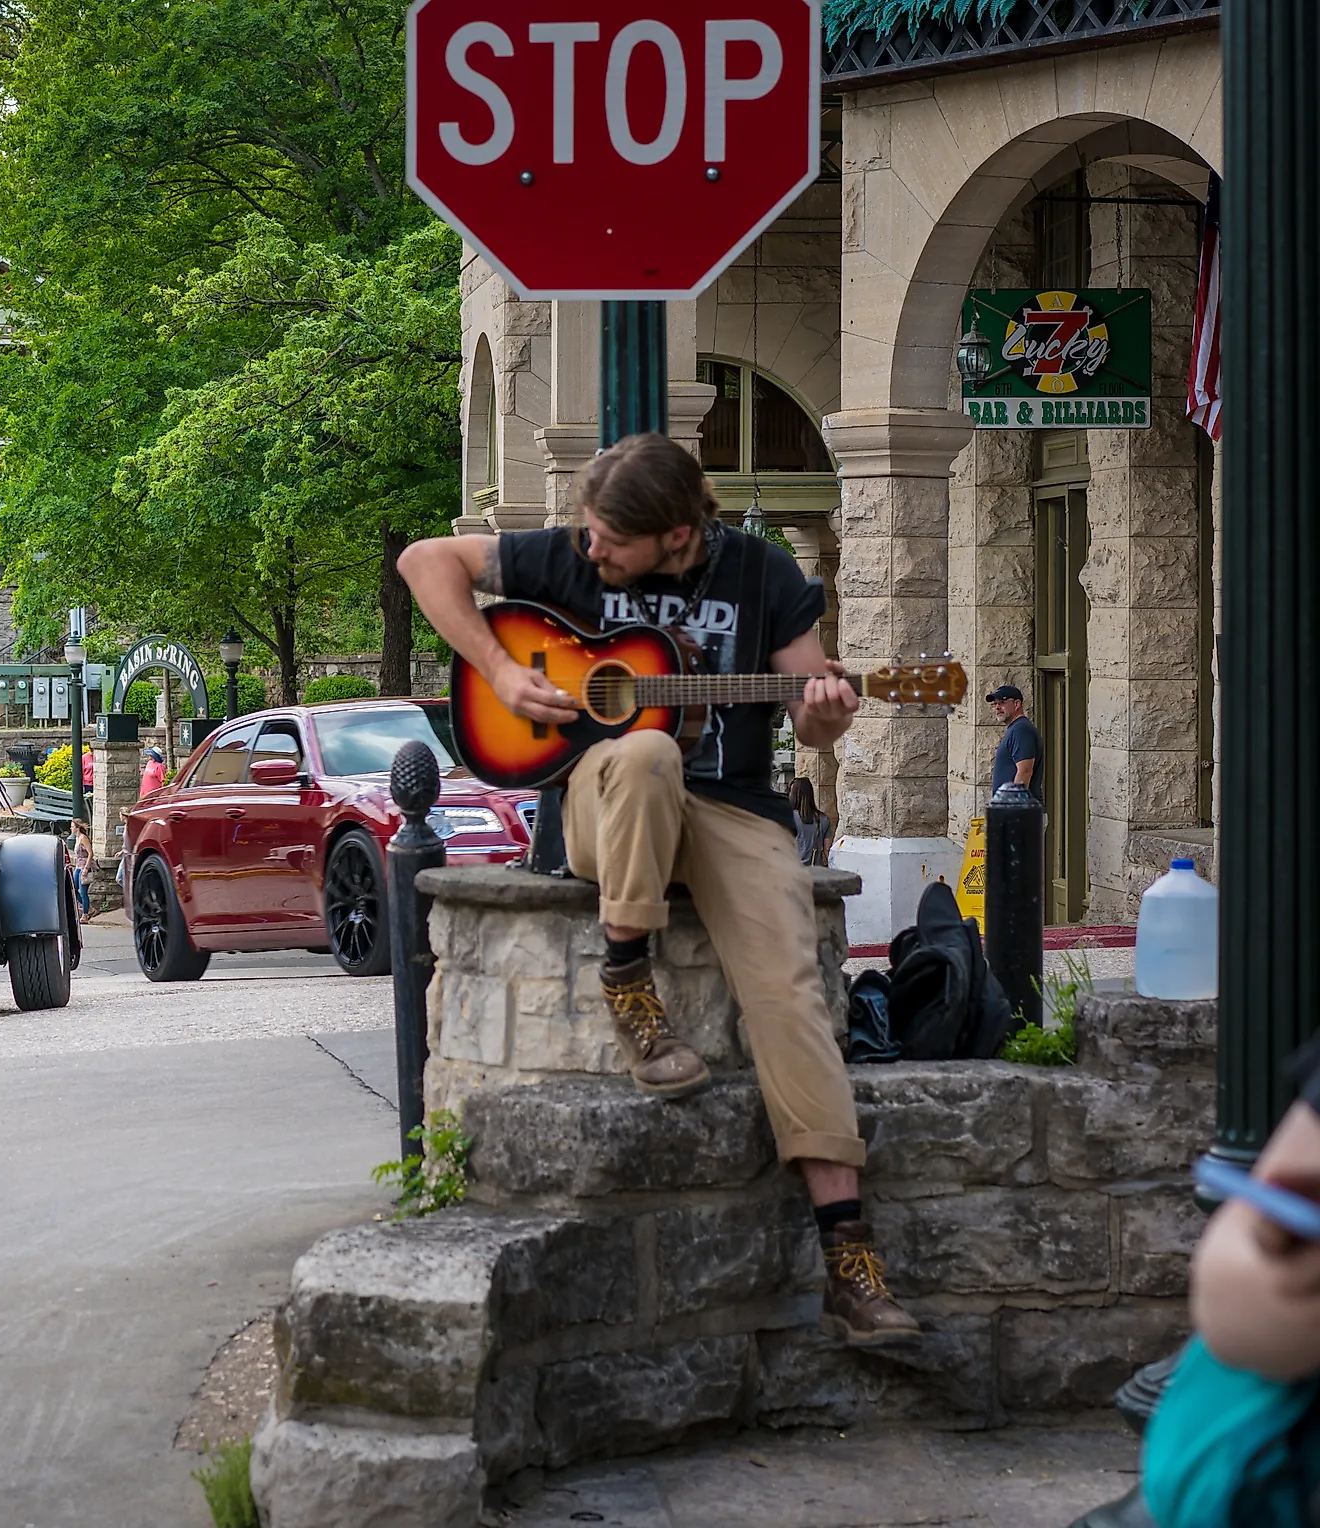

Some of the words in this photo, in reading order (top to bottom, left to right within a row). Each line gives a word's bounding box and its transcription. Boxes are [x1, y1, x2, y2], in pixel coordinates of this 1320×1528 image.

[438, 19, 784, 166] STOP
[1001, 320, 1111, 372] Lucky
[1025, 311, 1090, 376] 7
[968, 401, 1008, 426] BAR
[1016, 401, 1034, 426] &
[1041, 401, 1146, 425] BILLIARDS
[995, 383, 1012, 396] 6TH
[1099, 384, 1124, 396] FLOOR
[119, 642, 153, 691] BASIN
[155, 642, 200, 691] SPRING
